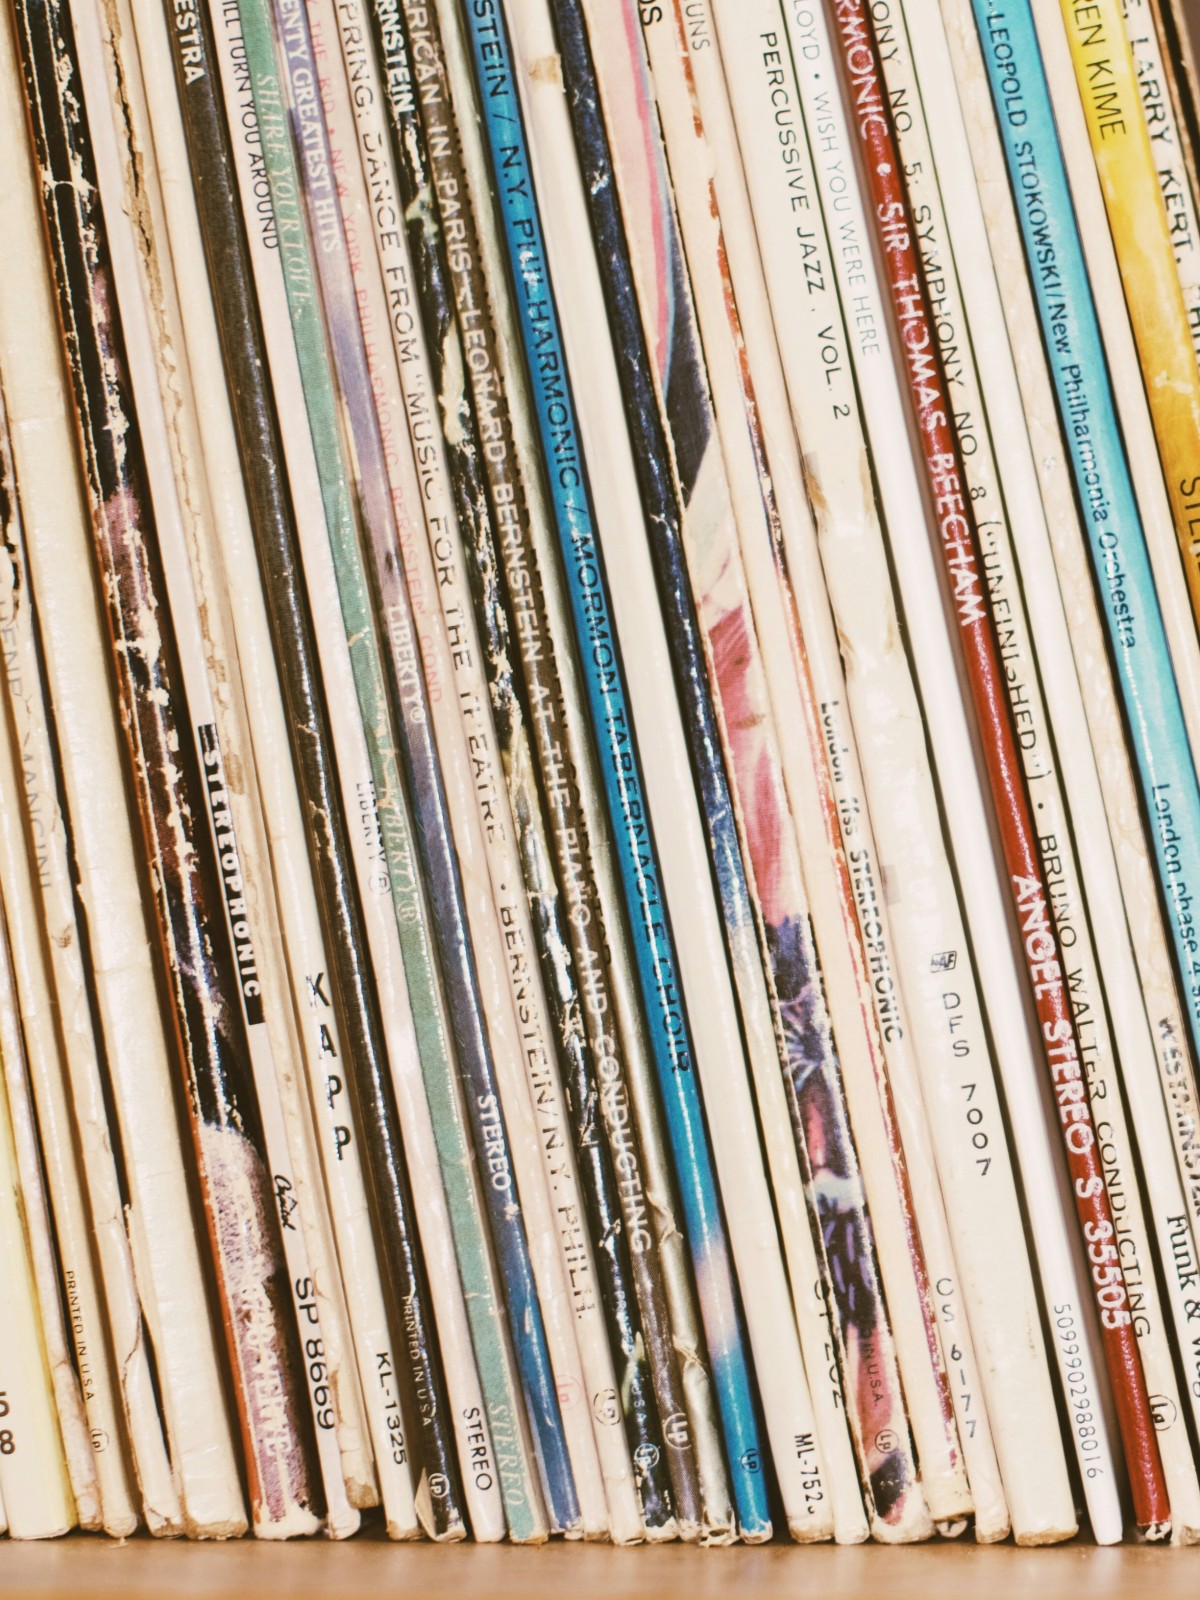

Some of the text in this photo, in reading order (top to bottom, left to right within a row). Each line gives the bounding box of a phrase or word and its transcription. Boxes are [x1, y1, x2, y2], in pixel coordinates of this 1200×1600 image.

[229, 36, 251, 92] TURN
[473, 0, 510, 98] STEIN
[1085, 59, 1126, 140] KIME
[240, 101, 261, 143] YOU
[256, 72, 285, 155] SHARE
[292, 68, 330, 192] GREATEST
[315, 200, 343, 253] HITS
[427, 126, 451, 158] IN
[814, 91, 840, 153] WISH
[1130, 36, 1173, 145] LARRY
[1159, 167, 1194, 264] KERT,
[248, 152, 279, 250] AROUND
[269, 163, 300, 232] YOUR
[436, 178, 473, 273] PARIS
[498, 144, 530, 205] N.Y.
[760, 31, 850, 420] PERCUSSIVE JAZZ VOL. 2
[825, 160, 853, 212] YOU
[876, 201, 912, 252] SIR
[839, 221, 868, 287] WERE
[889, 88, 913, 143] NO.
[911, 204, 966, 388] SYMPHONY
[954, 411, 979, 467] NO.
[969, 486, 988, 503] 8
[310, 21, 327, 58] THE
[319, 76, 336, 115] KID
[332, 148, 350, 198] NEW
[343, 214, 364, 274] YORK
[390, 484, 428, 615] BERNSTEIN
[512, 218, 581, 490] PHILHARMONIC
[852, 295, 880, 357] HERE
[892, 273, 947, 431] THOMAS
[985, 14, 1028, 127] LEOPOLD
[1060, 363, 1110, 522] Philharmonia
[1099, 531, 1136, 649] Orchestra
[362, 132, 401, 251] DANCE
[385, 264, 421, 364] FROM
[429, 515, 455, 588] FOR
[445, 606, 474, 670] THE
[458, 307, 507, 462] LEONARD
[492, 483, 545, 663] BERNSTEIN
[927, 452, 987, 627] BEECHAM
[385, 603, 425, 710] LIBERTY
[570, 534, 621, 695] MORMON
[540, 741, 571, 808] THE
[604, 708, 668, 944] TABERNACLE
[202, 750, 262, 998] STEREOPHONIC
[554, 828, 592, 927] PIANO
[821, 700, 849, 783] London
[850, 848, 903, 1044] STEREOPHONIC
[1151, 781, 1181, 875] London
[1166, 881, 1199, 953] phase
[576, 949, 611, 1014] AND
[648, 957, 690, 1074] CHOIR
[304, 971, 352, 1161] KAPP
[1012, 875, 1132, 1330] ANGEL STEREO S 35505
[1038, 833, 1151, 1339] BRUNO WALTER CONDUCTING
[476, 1094, 512, 1192] STEREO
[593, 1034, 652, 1253] CONDUCTING
[1166, 1214, 1199, 1292] Funk
[66, 1270, 84, 1334] PRINTED
[76, 1341, 88, 1356] IN
[295, 1276, 336, 1430] SP 8669
[402, 1295, 420, 1360] PRINTED
[414, 1365, 425, 1382] IN
[376, 1352, 409, 1466] KL-1325
[1053, 1304, 1103, 1479] 5099902988016
[463, 1406, 494, 1492] STEREO
[489, 1402, 526, 1507] STEREO
